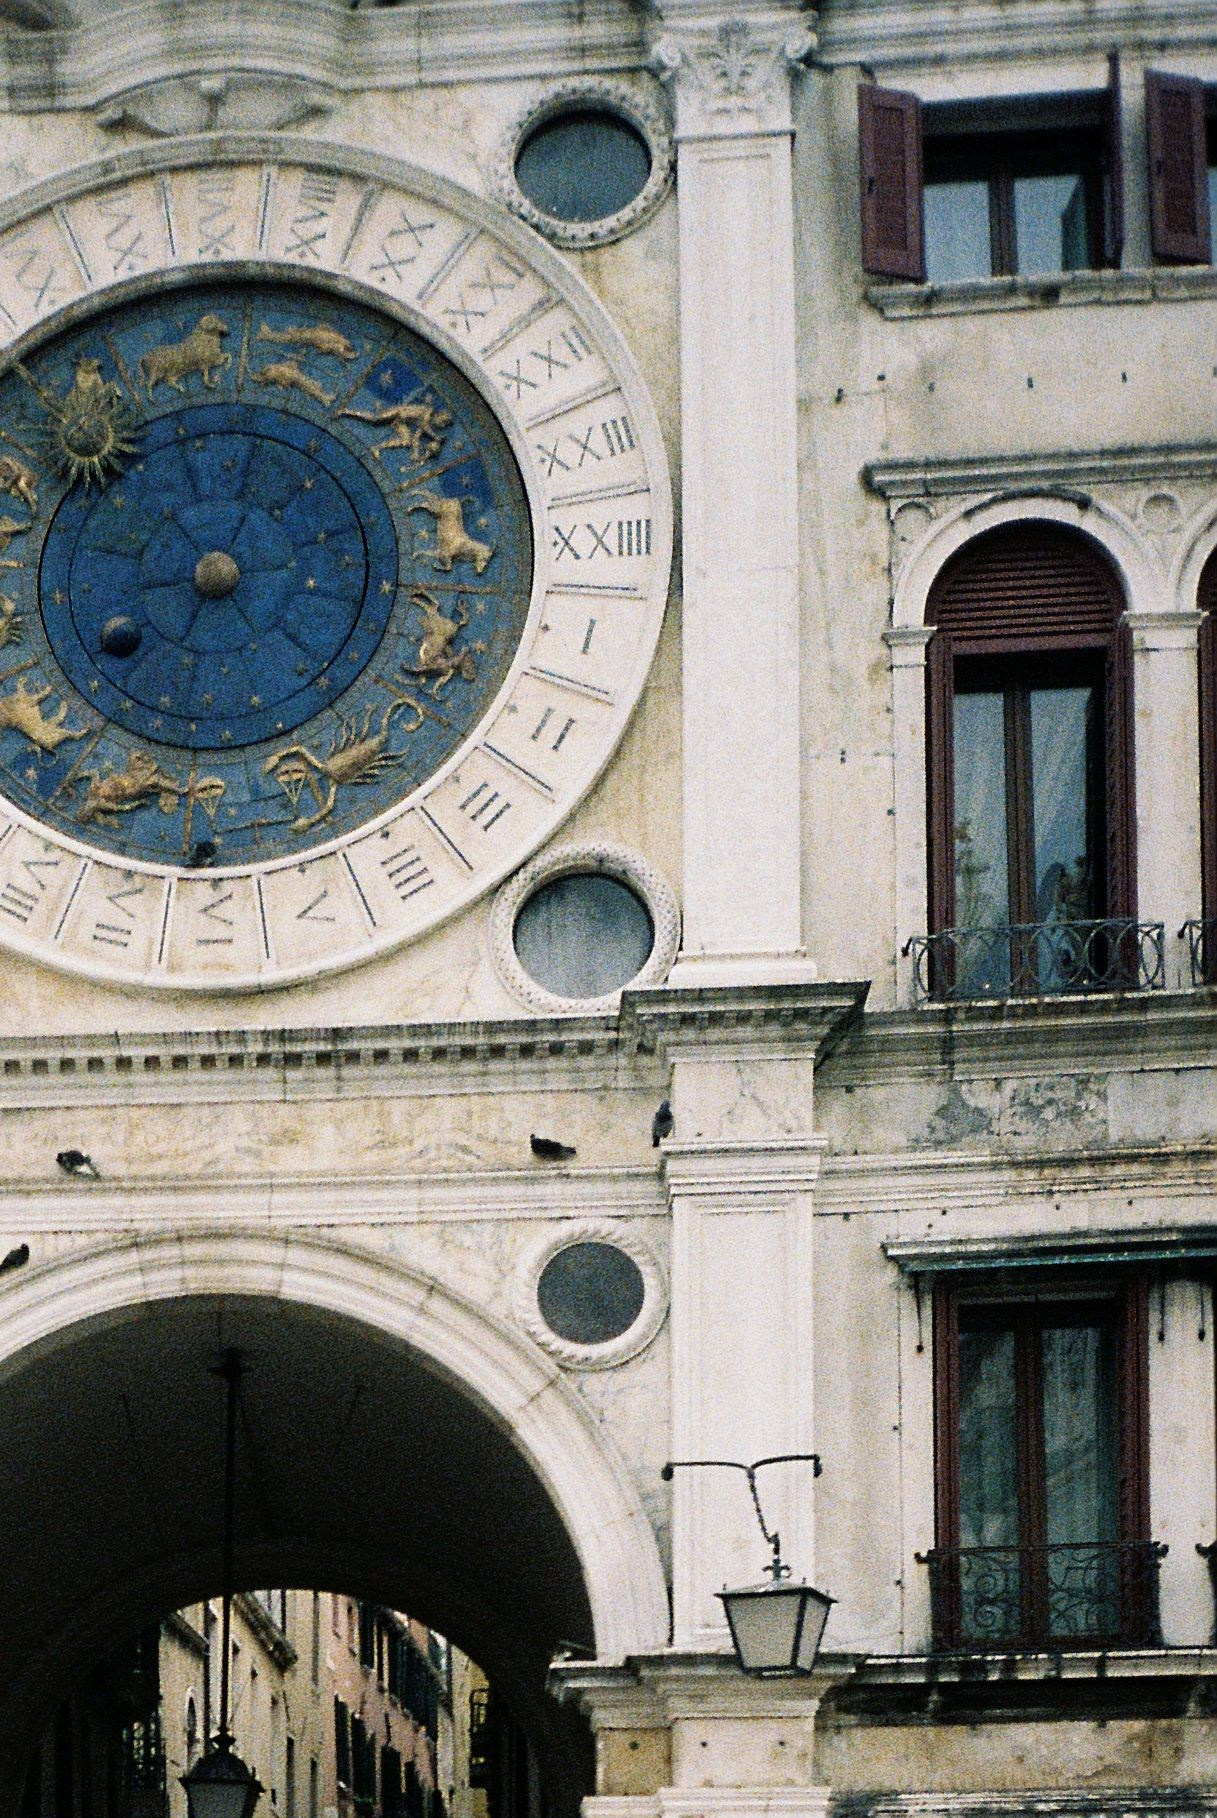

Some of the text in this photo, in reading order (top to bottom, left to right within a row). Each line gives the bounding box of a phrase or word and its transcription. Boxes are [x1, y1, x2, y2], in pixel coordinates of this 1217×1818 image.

[370, 211, 434, 282] XX
[441, 250, 524, 334] XXI
[498, 325, 592, 400] XXII
[536, 416, 635, 477] XXIII
[553, 518, 651, 560] XXIIII
[531, 707, 575, 751] II
[458, 781, 511, 832] III
[380, 844, 434, 900] IIII
[92, 886, 146, 948] VII
[195, 891, 233, 946] VI
[296, 889, 335, 922] V
